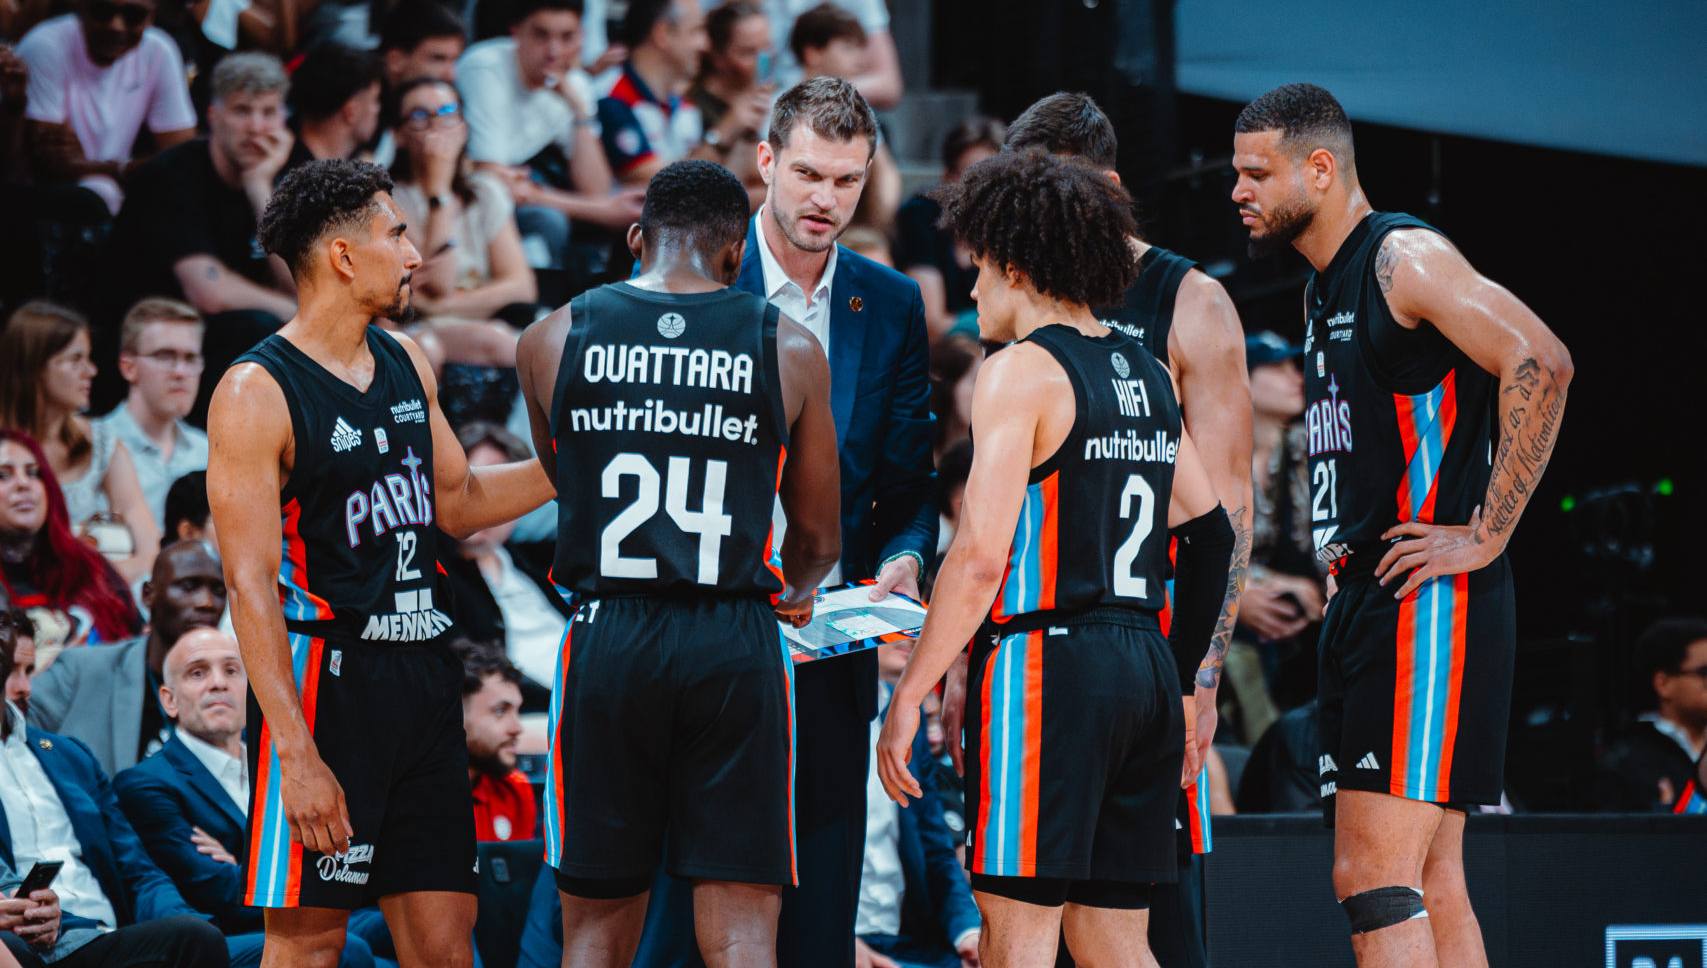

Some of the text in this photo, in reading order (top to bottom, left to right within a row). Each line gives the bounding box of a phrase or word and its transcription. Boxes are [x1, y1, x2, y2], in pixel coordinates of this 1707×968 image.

[583, 344, 754, 394] OUATTARA
[1111, 379, 1151, 417] HIFI
[330, 430, 362, 453] snipes
[346, 446, 433, 549] PARIS
[600, 452, 732, 586] 24
[1312, 459, 1338, 522] 21
[395, 530, 422, 582] 12
[1113, 474, 1155, 600] 2
